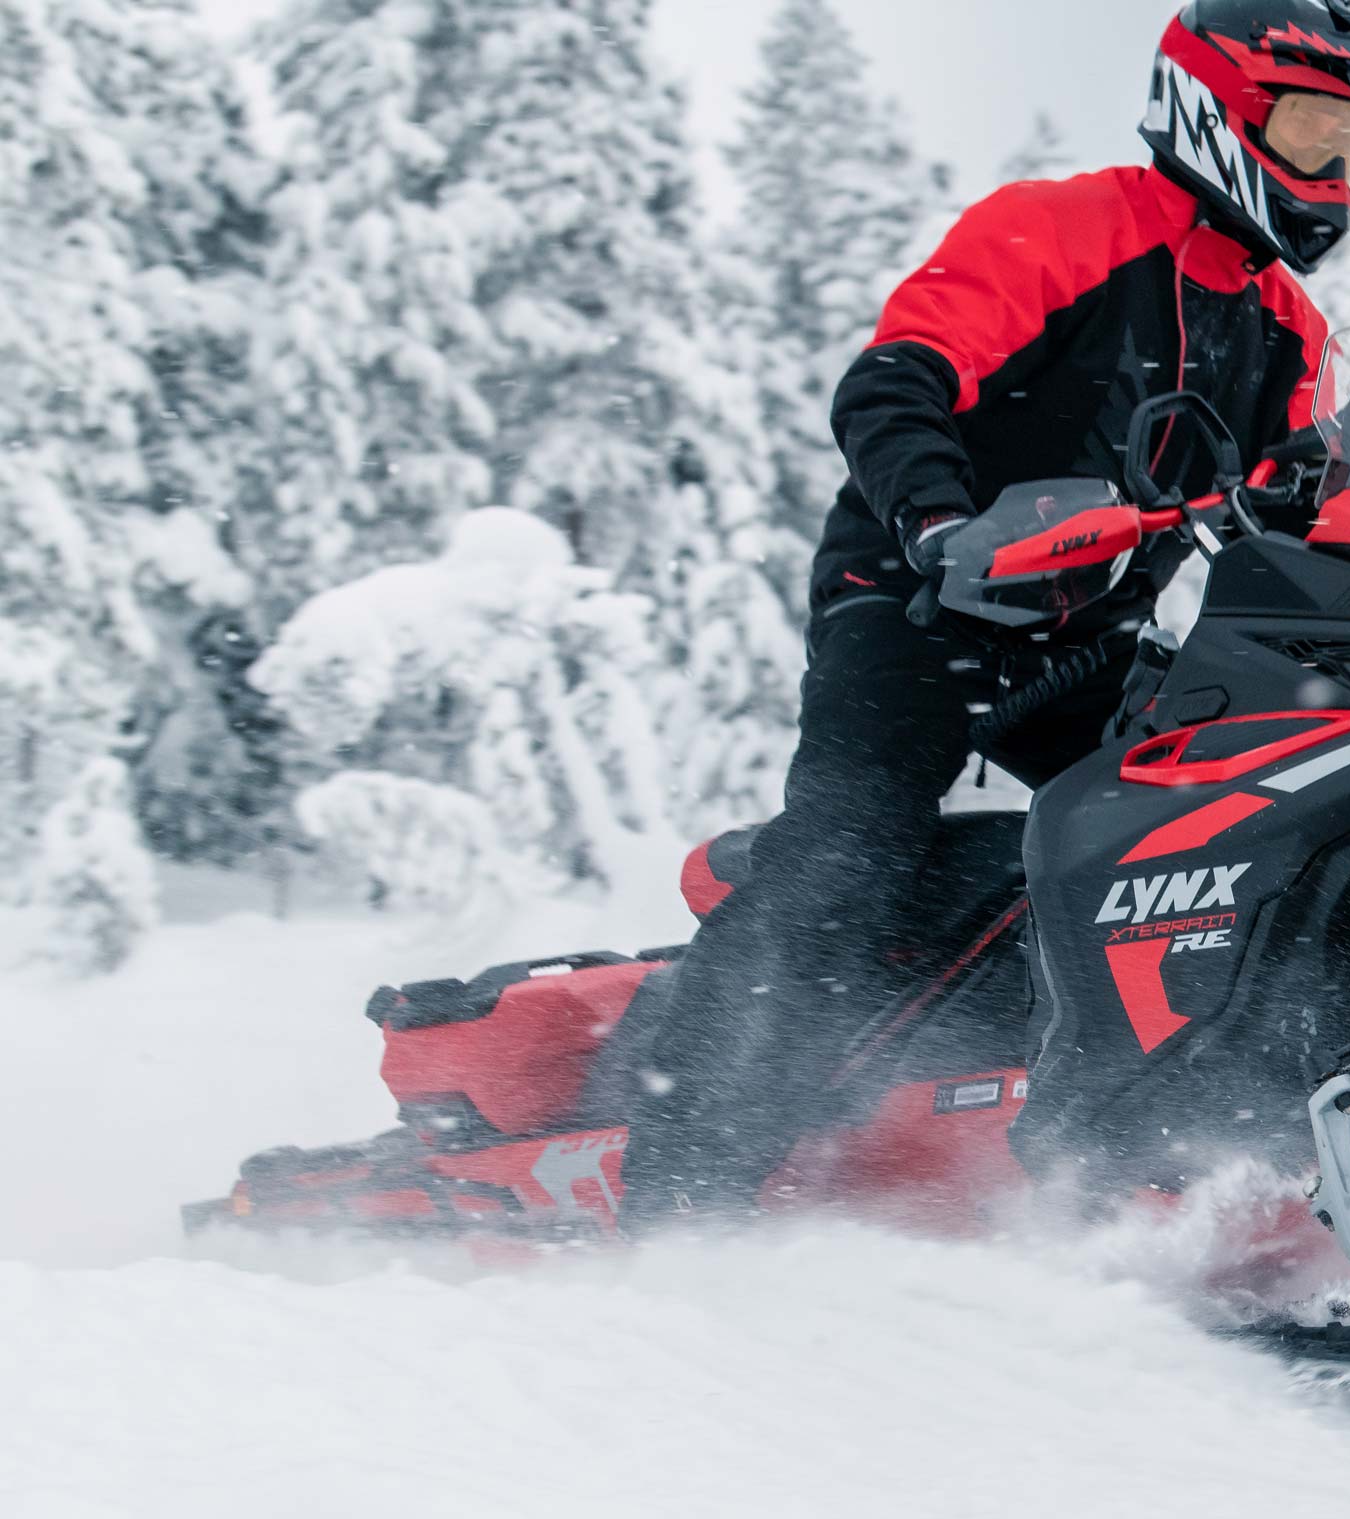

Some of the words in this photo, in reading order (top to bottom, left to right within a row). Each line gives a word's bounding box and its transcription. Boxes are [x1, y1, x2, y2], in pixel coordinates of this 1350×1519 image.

[1051, 530, 1102, 555] LYNX
[1095, 862, 1252, 924] LYNX
[1107, 913, 1236, 942] XTERRAIN
[1171, 929, 1232, 953] RE
